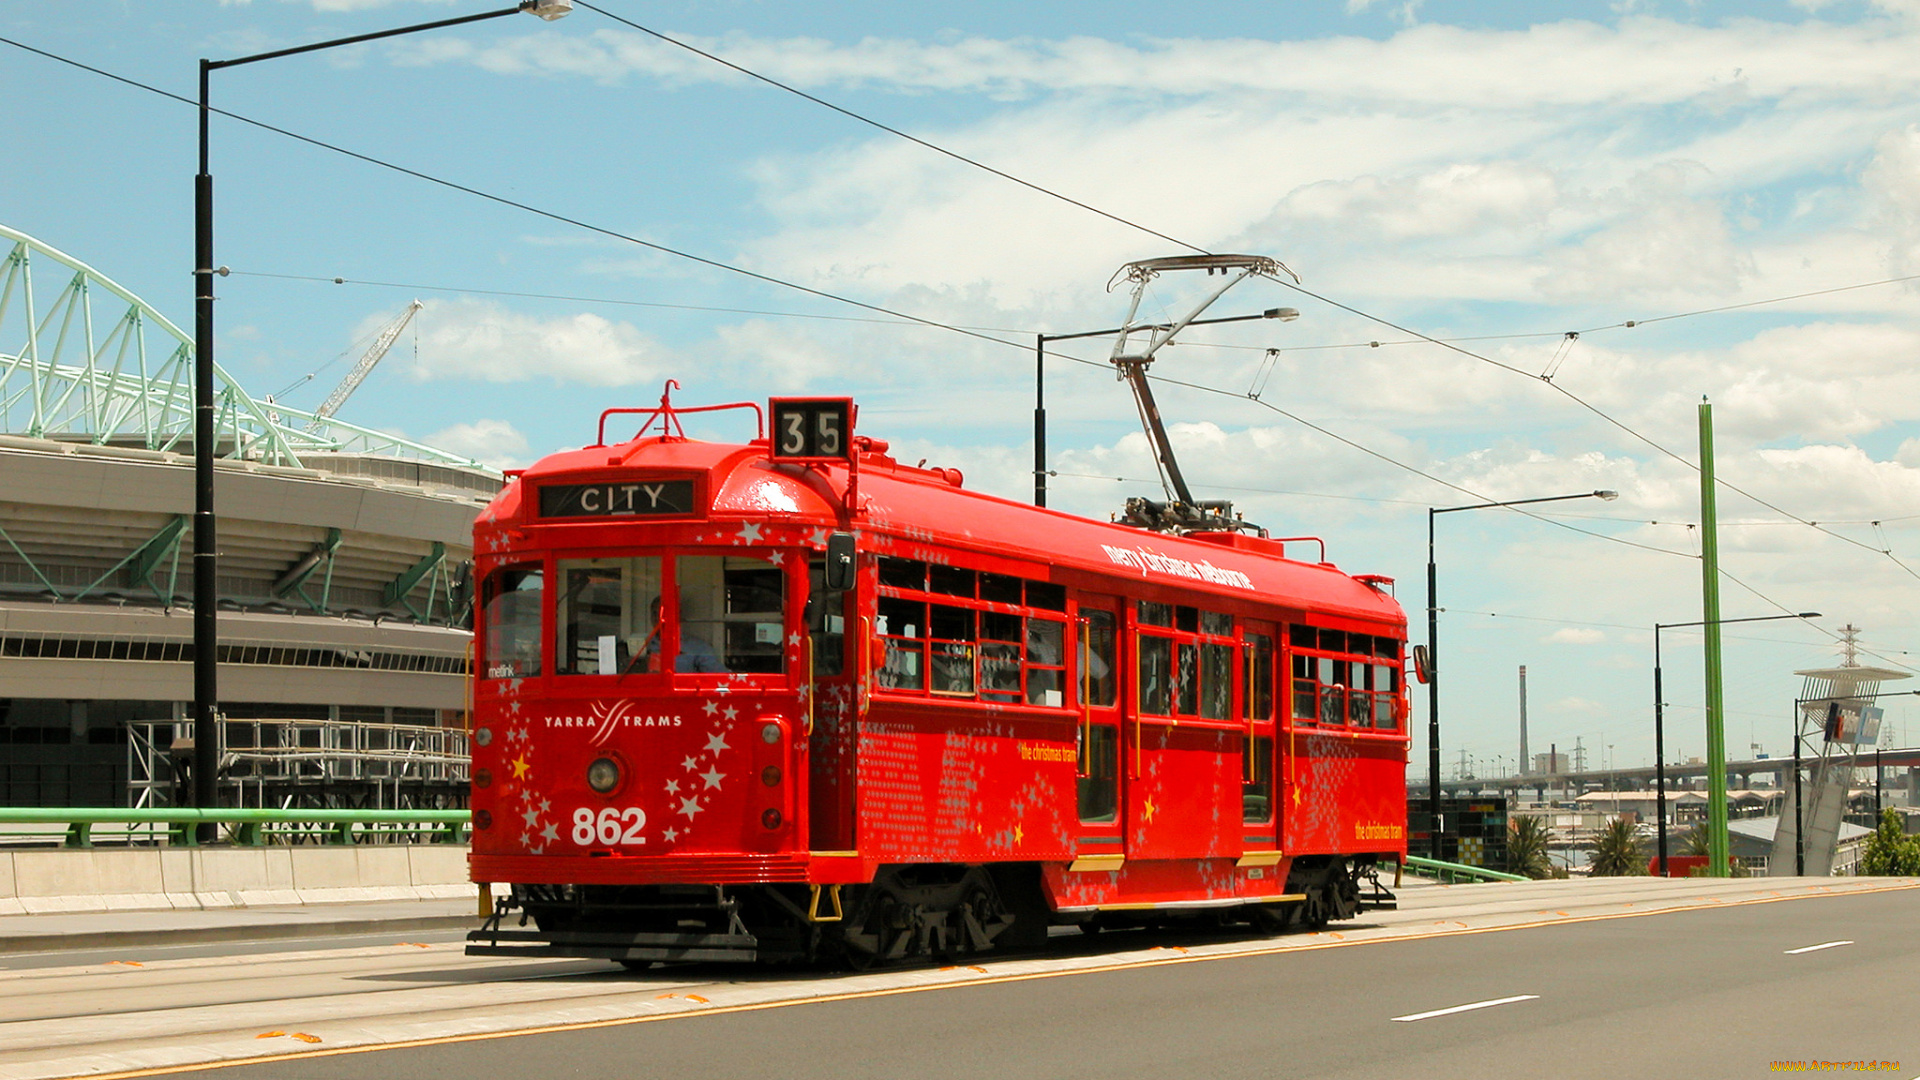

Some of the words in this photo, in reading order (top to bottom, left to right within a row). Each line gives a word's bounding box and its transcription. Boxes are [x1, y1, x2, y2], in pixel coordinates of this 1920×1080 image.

[783, 413, 839, 454] 35
[581, 484, 665, 511] CITY
[1100, 544, 1147, 577] merry
[1136, 545, 1202, 580] christmas
[1192, 558, 1255, 591] melbourne
[545, 716, 596, 728] YARRA
[623, 715, 682, 727] TRAMS
[1021, 742, 1032, 760] the
[1032, 742, 1062, 762] christmas
[1062, 745, 1077, 762] tram
[572, 807, 647, 846] 862
[1355, 820, 1365, 840] the
[1365, 820, 1390, 840] christmas
[1390, 822, 1403, 840] tram
